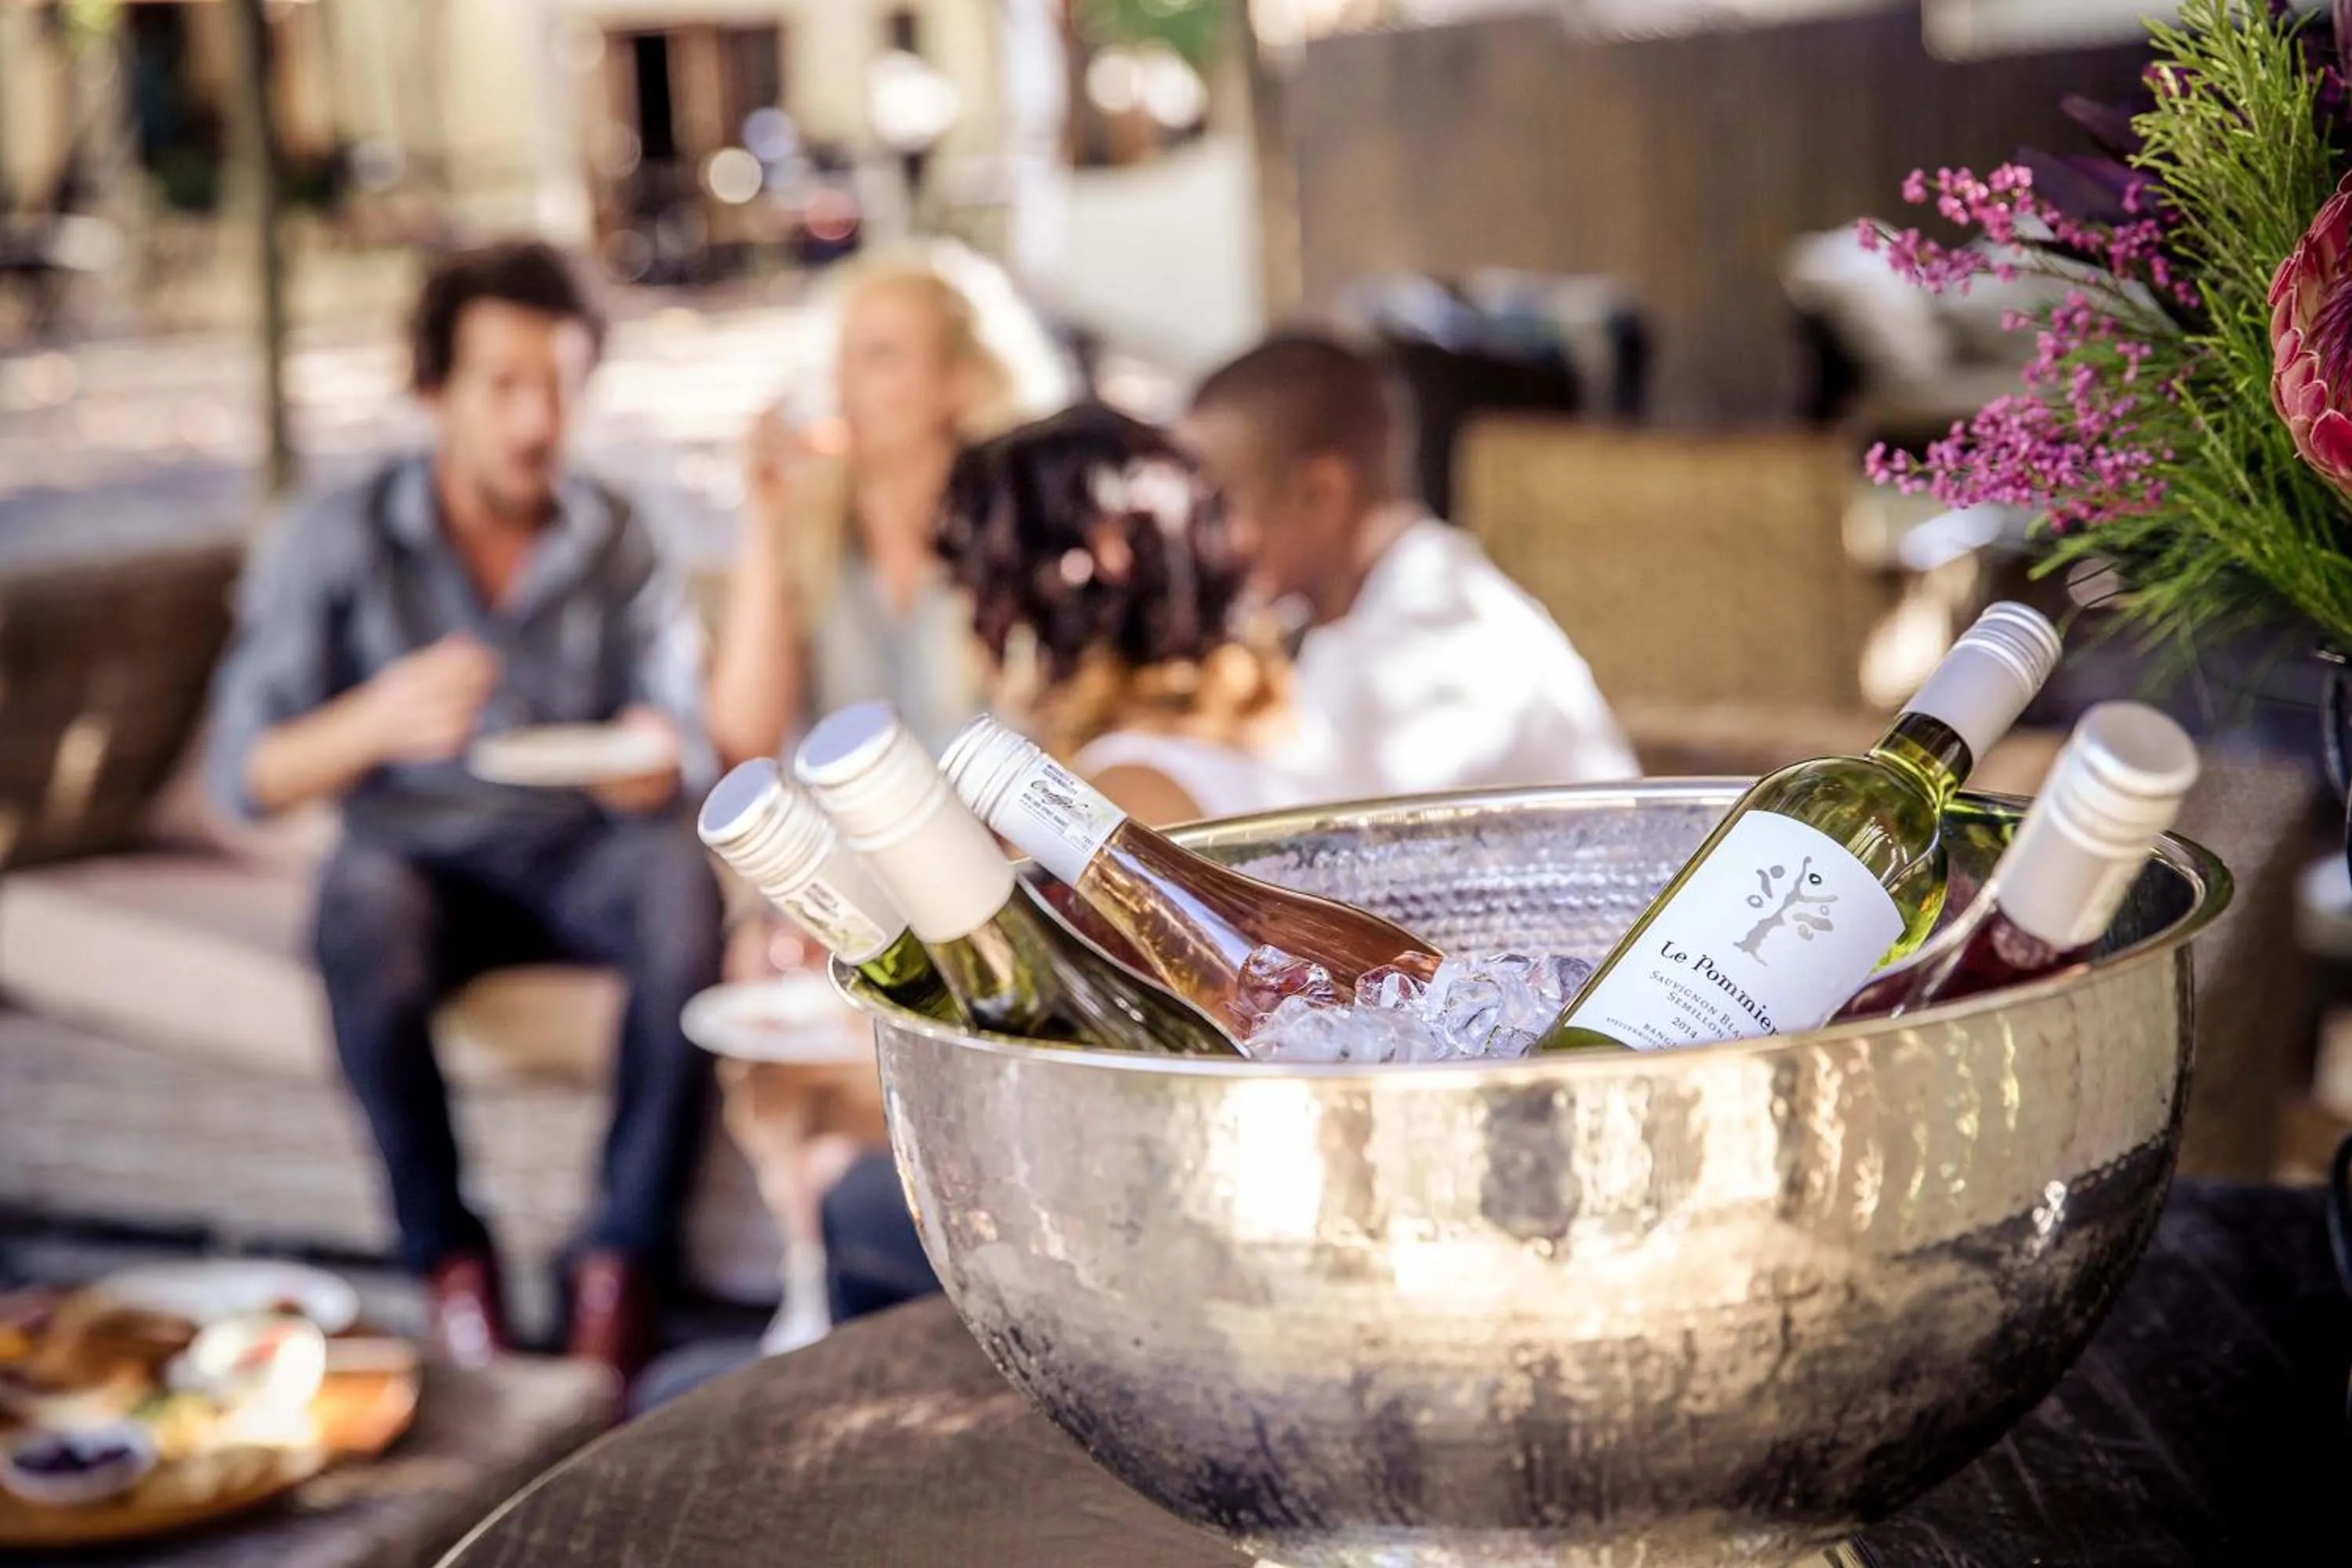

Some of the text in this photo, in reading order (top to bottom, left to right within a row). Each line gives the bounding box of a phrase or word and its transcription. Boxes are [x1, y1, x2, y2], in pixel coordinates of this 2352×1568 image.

[1649, 970, 1719, 1015] SAUVIGNON
[1660, 940, 1780, 1036] Le Pommier
[1666, 990, 1725, 1039] SEMILLON
[1671, 1016, 1698, 1040] 2014
